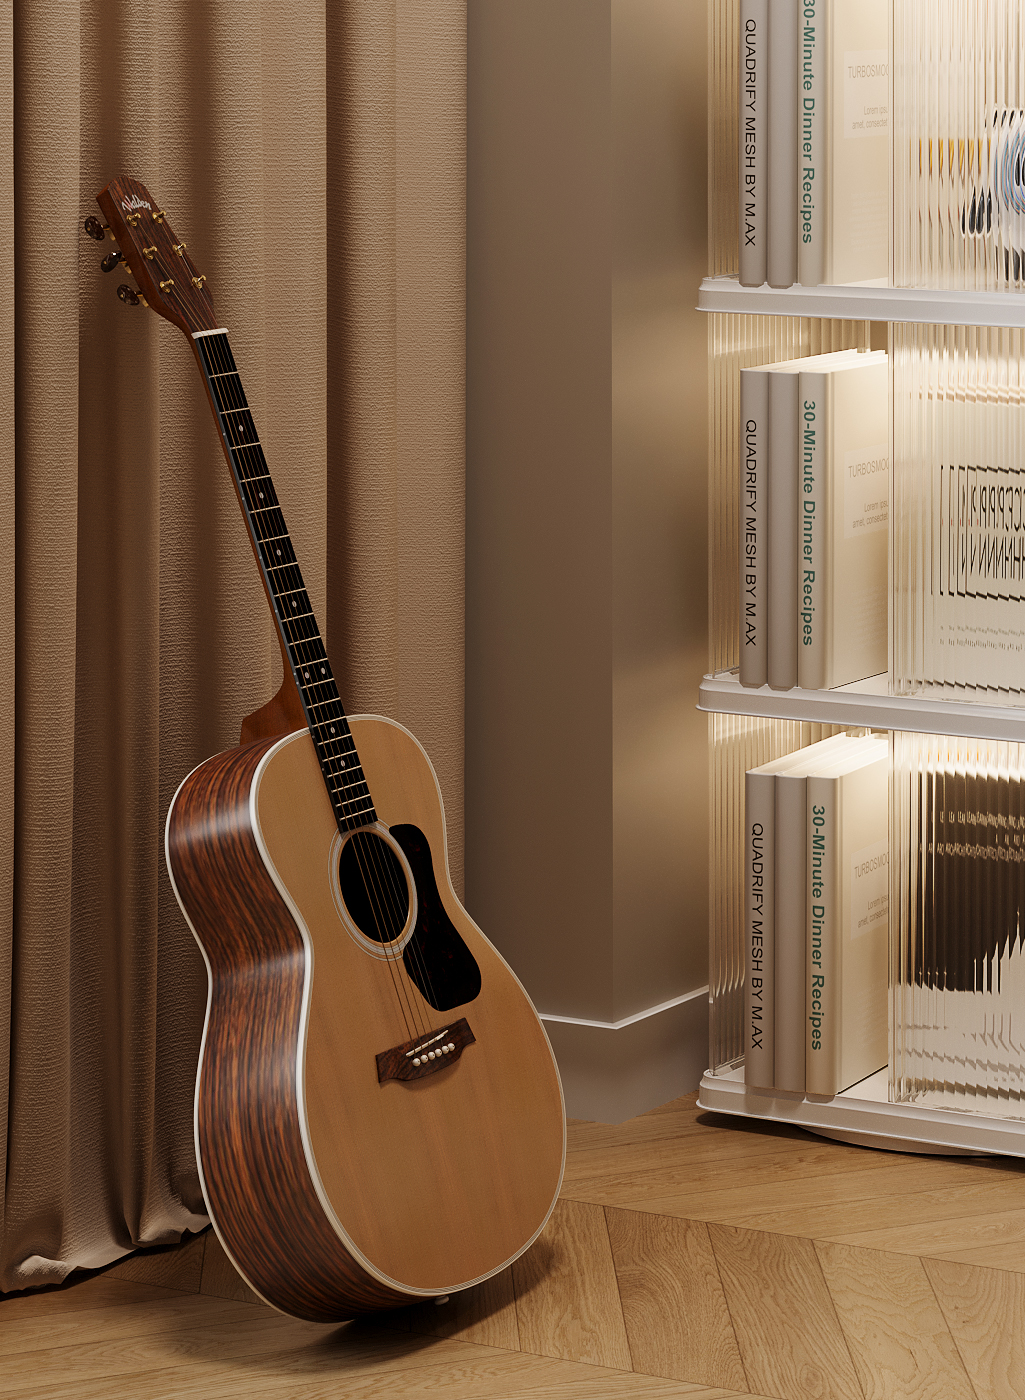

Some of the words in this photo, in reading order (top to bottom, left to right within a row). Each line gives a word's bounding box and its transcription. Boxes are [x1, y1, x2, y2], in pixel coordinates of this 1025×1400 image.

[745, 20, 756, 111] QUADRIFY
[745, 117, 756, 167] MESH
[803, 98, 815, 161] Dinner
[745, 174, 756, 197] BY
[799, 168, 815, 243] Recipes
[745, 203, 756, 246] M.AX
[746, 420, 756, 512] QUADRIFY
[804, 401, 816, 493] 30-Minute
[746, 518, 756, 568] MESH
[804, 501, 816, 564] Dinner
[746, 574, 756, 597] BY
[800, 570, 816, 646] Recipes
[746, 603, 756, 646] M.AX
[752, 823, 763, 915] QUADRIFY
[812, 805, 825, 898] 30-Minute
[752, 921, 763, 971] MESH
[812, 905, 825, 968] Dinner
[752, 978, 763, 1001] BY
[808, 975, 825, 1050] Recipes
[752, 1006, 763, 1049] M.AX
